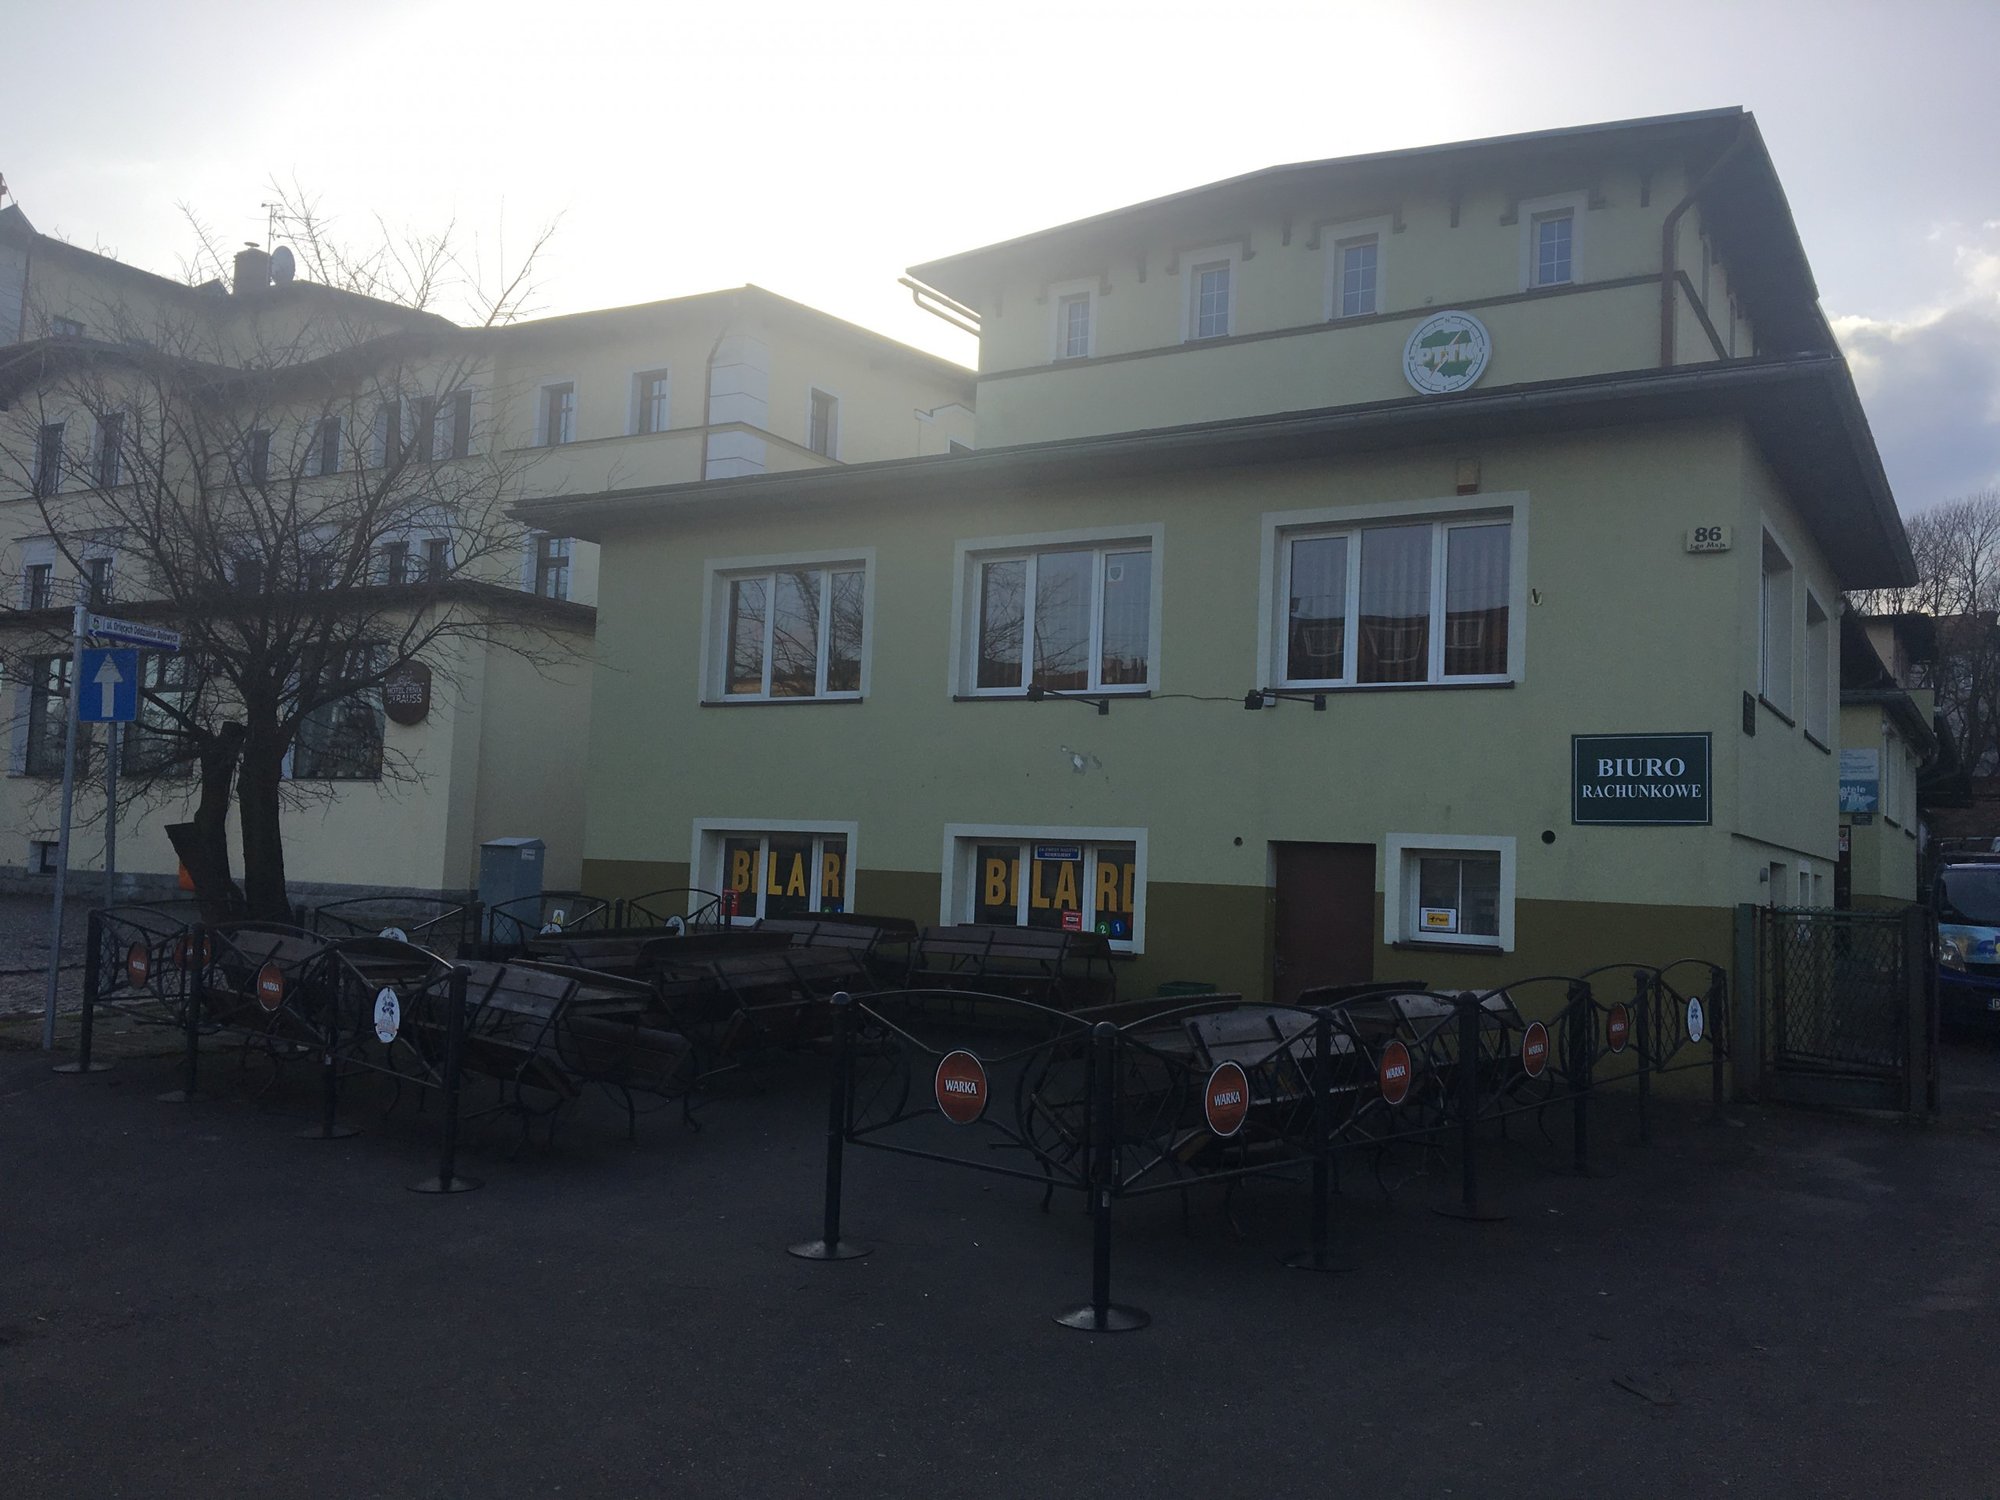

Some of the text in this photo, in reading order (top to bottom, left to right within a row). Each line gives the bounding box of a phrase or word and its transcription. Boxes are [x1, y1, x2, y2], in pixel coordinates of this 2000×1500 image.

[1416, 342, 1474, 365] PTTK
[1694, 526, 1722, 542] 86
[1597, 757, 1686, 777] BIURO
[1582, 784, 1702, 798] RACHUNKOWE
[1840, 785, 1866, 793] otele
[731, 849, 846, 898] BILAR
[1528, 1043, 1544, 1055] WARKA
[1385, 1065, 1406, 1080] WARKA
[945, 1079, 977, 1095] WARKA
[1214, 1091, 1241, 1107] WARKA
